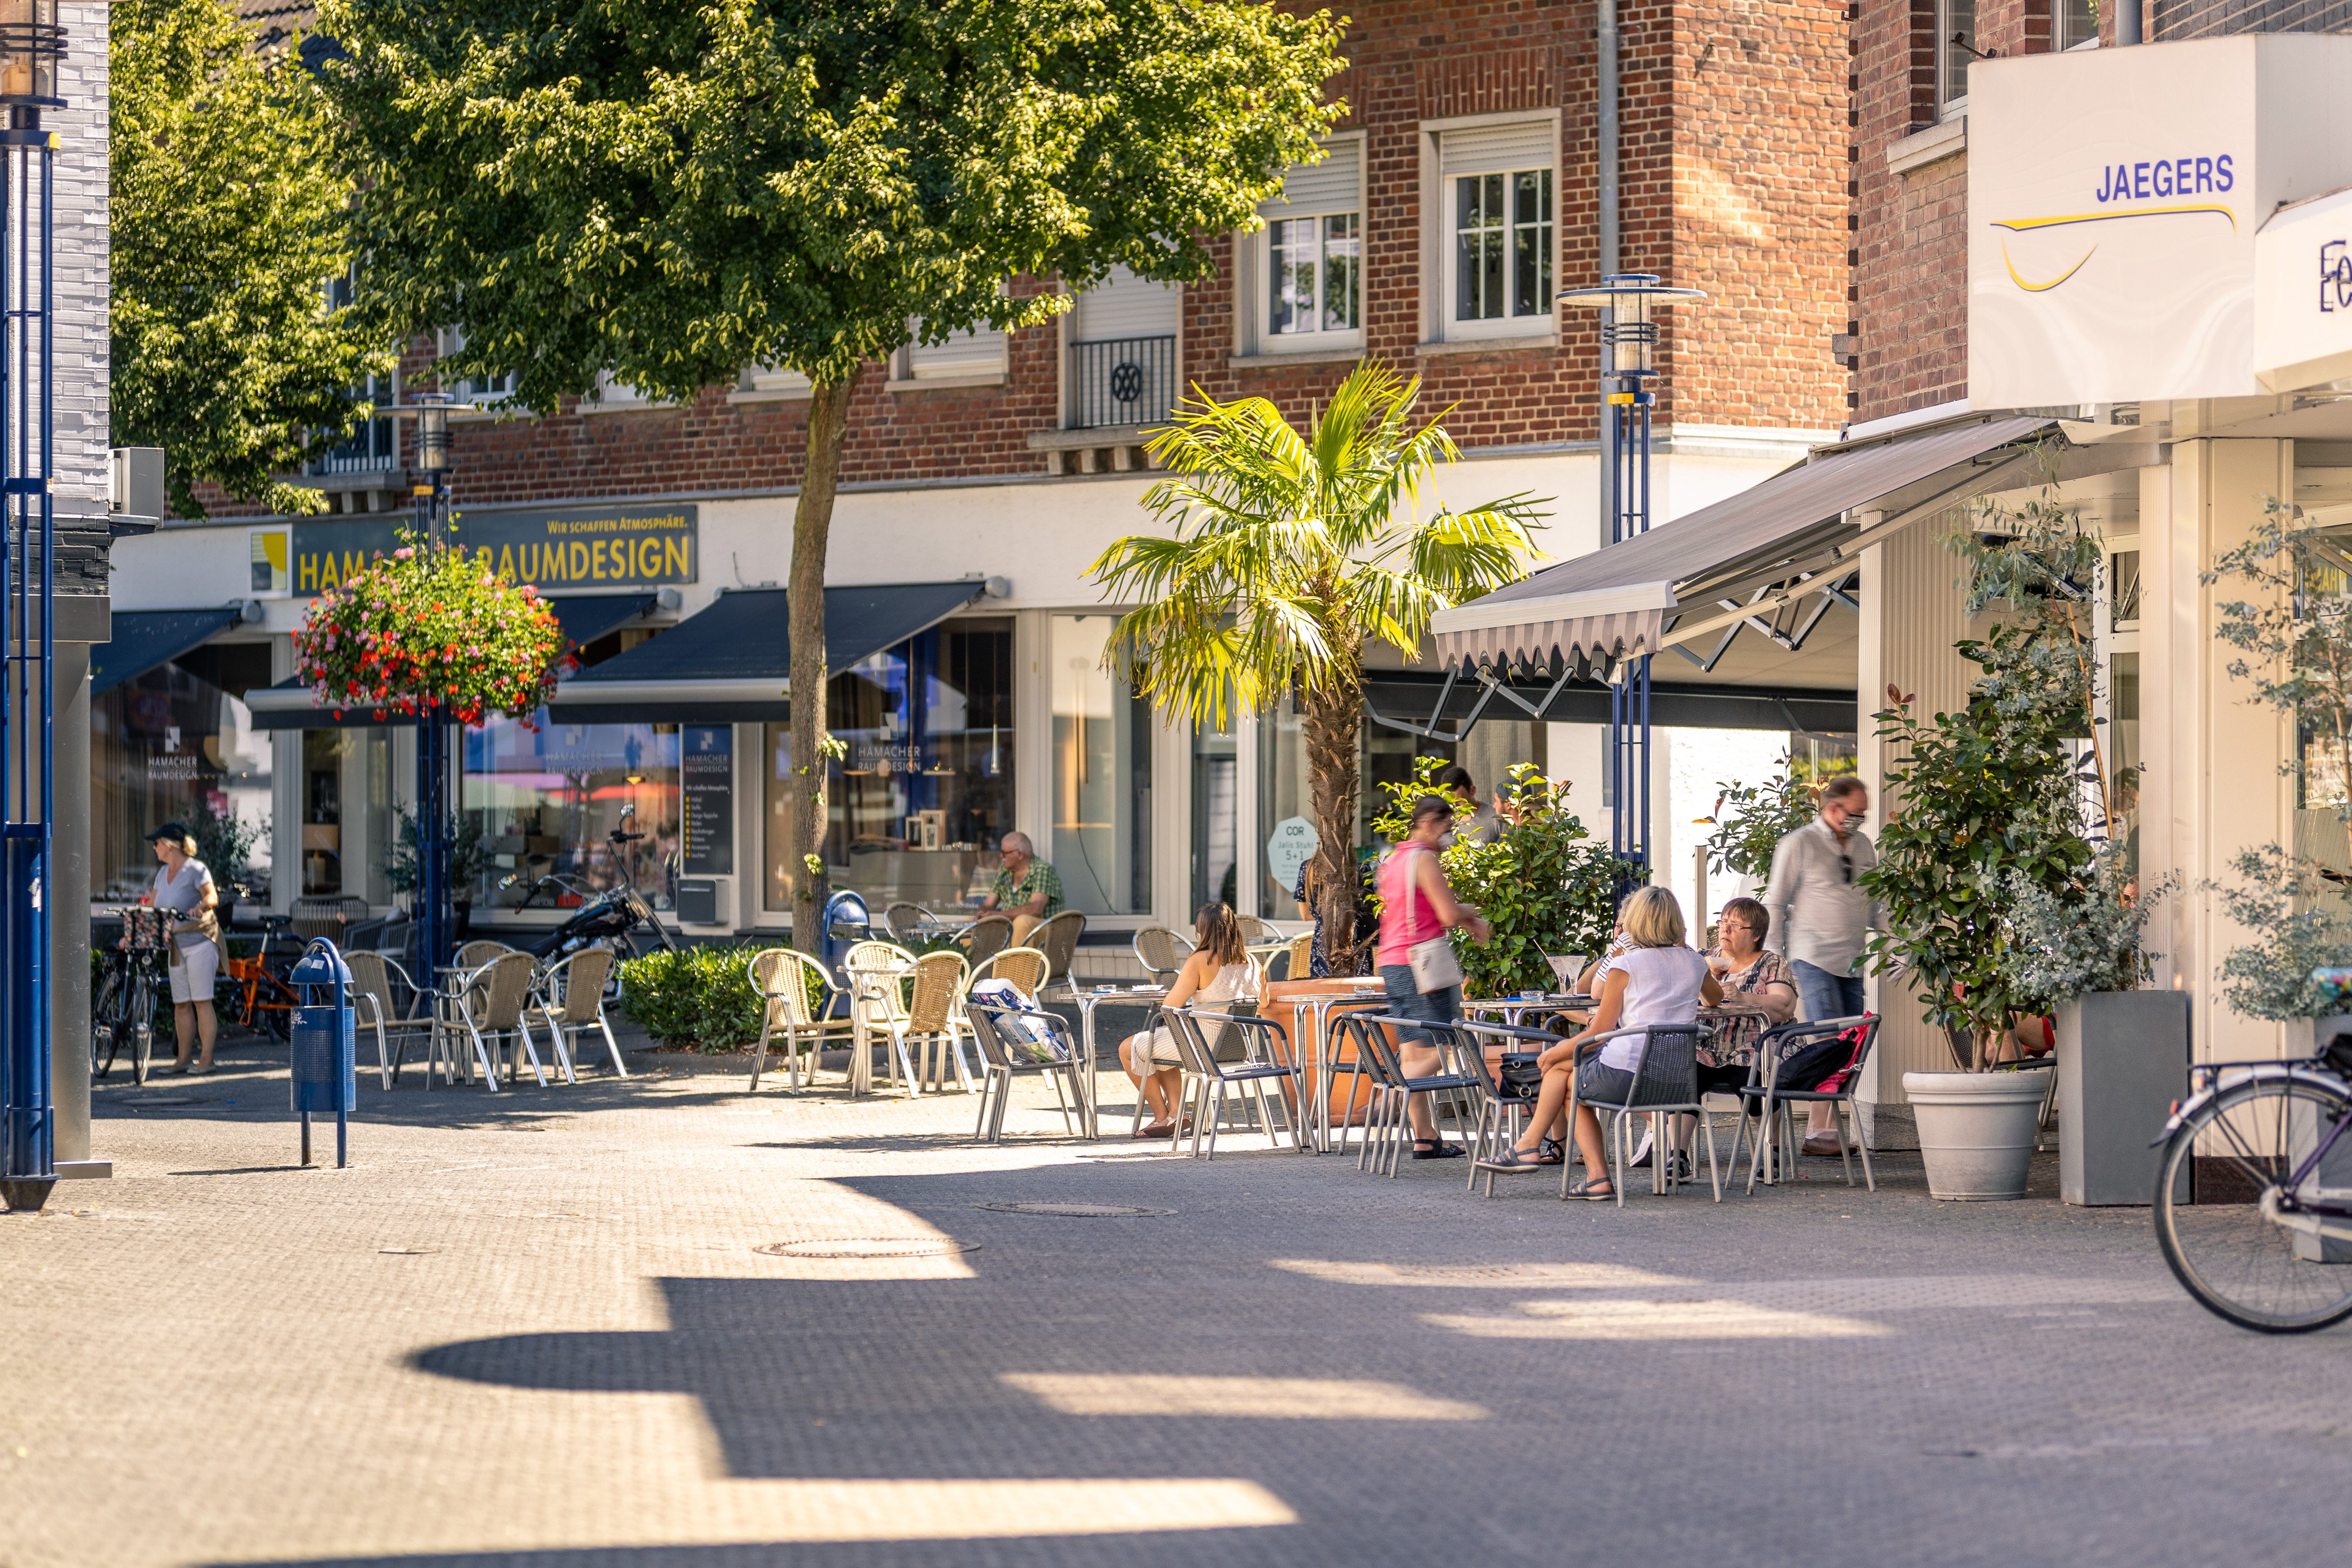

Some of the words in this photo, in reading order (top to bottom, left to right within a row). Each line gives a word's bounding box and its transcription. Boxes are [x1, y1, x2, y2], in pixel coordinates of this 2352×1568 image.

[2096, 154, 2234, 202] JAEGERS
[546, 751, 603, 762] HAMACHER
[858, 746, 920, 757] HAMACHER
[148, 755, 197, 768] HAMACHER
[685, 754, 727, 763] HAMACHER
[148, 770, 198, 781] RAUMDESIGN
[546, 767, 603, 775] RAUMDESIGN
[1286, 826, 1304, 836] COR
[1285, 850, 1304, 860] 5+1
